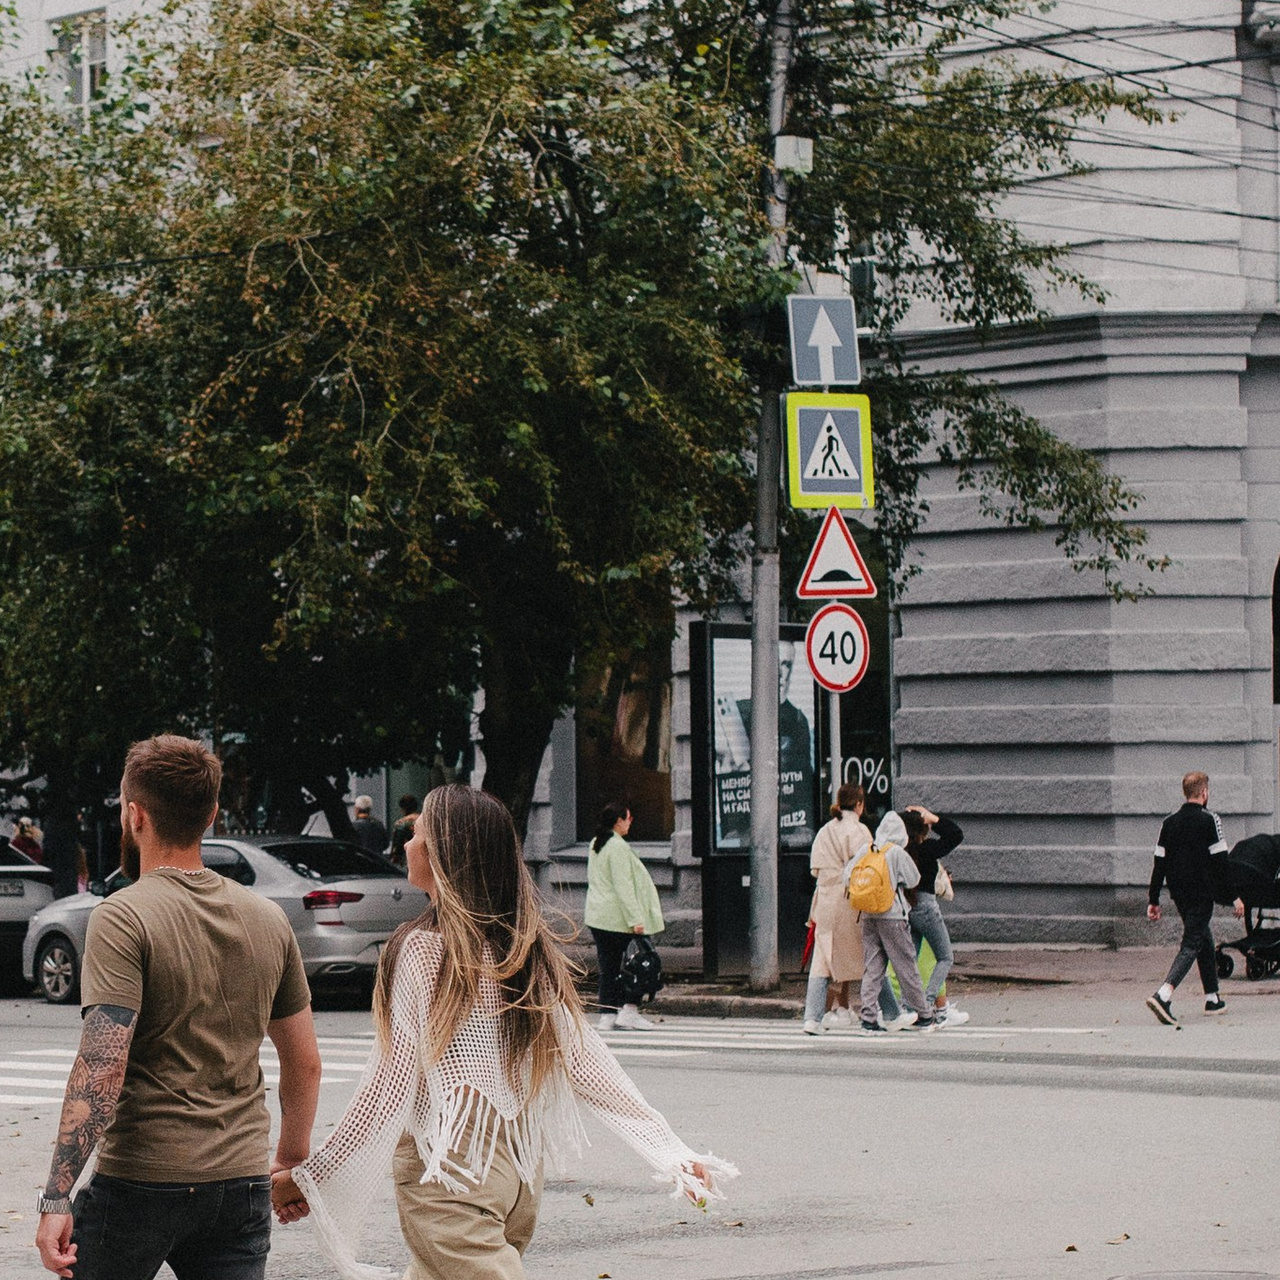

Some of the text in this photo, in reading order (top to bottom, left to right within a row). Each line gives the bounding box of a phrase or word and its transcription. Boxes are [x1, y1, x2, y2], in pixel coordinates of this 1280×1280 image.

[818, 630, 857, 666] 40
[722, 790, 736, 802] НА
[723, 803, 731, 814] И
